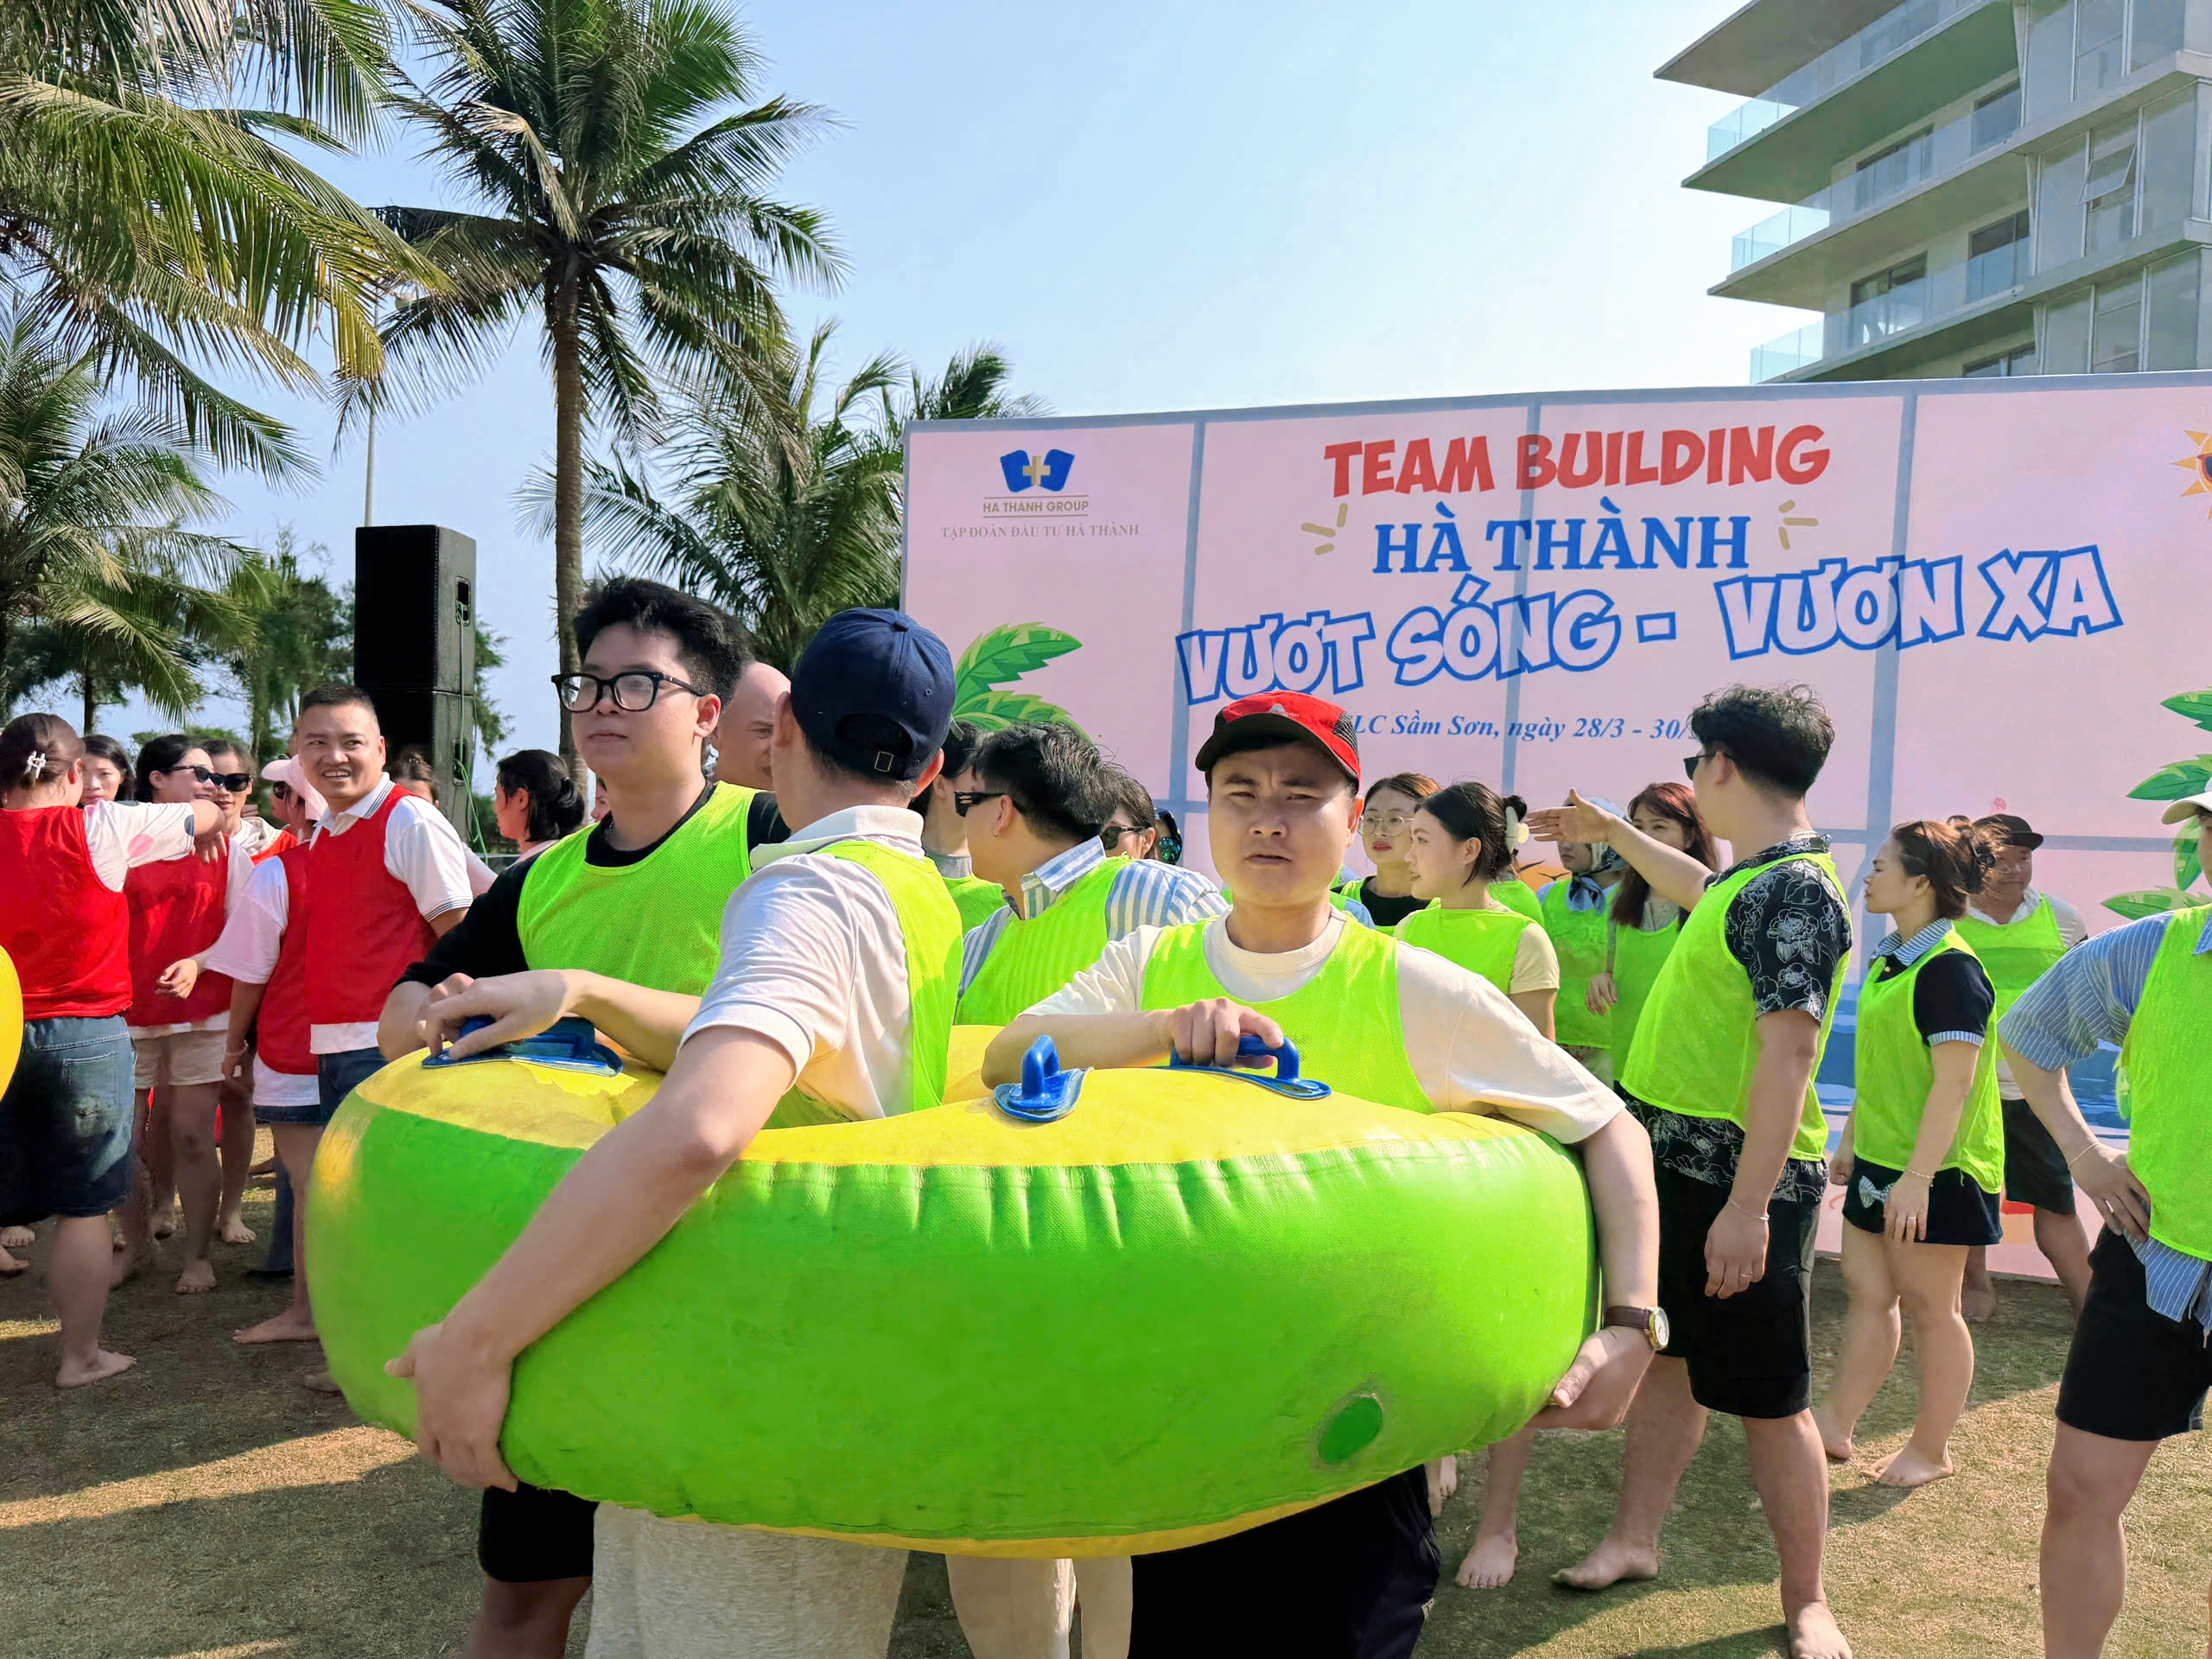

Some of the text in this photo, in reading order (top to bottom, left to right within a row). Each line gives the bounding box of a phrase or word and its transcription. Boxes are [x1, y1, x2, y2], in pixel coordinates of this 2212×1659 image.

[1324, 424, 1830, 498] TEAM BUILDING
[982, 500, 1089, 512] HA THANH GROUP
[1089, 520, 1140, 537] THÀNH
[1372, 495, 1751, 574] HÀ THÀNH
[1386, 573, 1621, 686] SÓNG
[1713, 555, 1965, 660] VƯƠN
[1977, 544, 2124, 643] XA
[1347, 715, 1387, 734] LC
[1391, 709, 1441, 734] Sầm
[1447, 715, 1499, 740] Sơn,
[1508, 717, 1566, 742] ngày
[1573, 718, 1625, 738] 28/3
[1649, 719, 1699, 740] 30/
